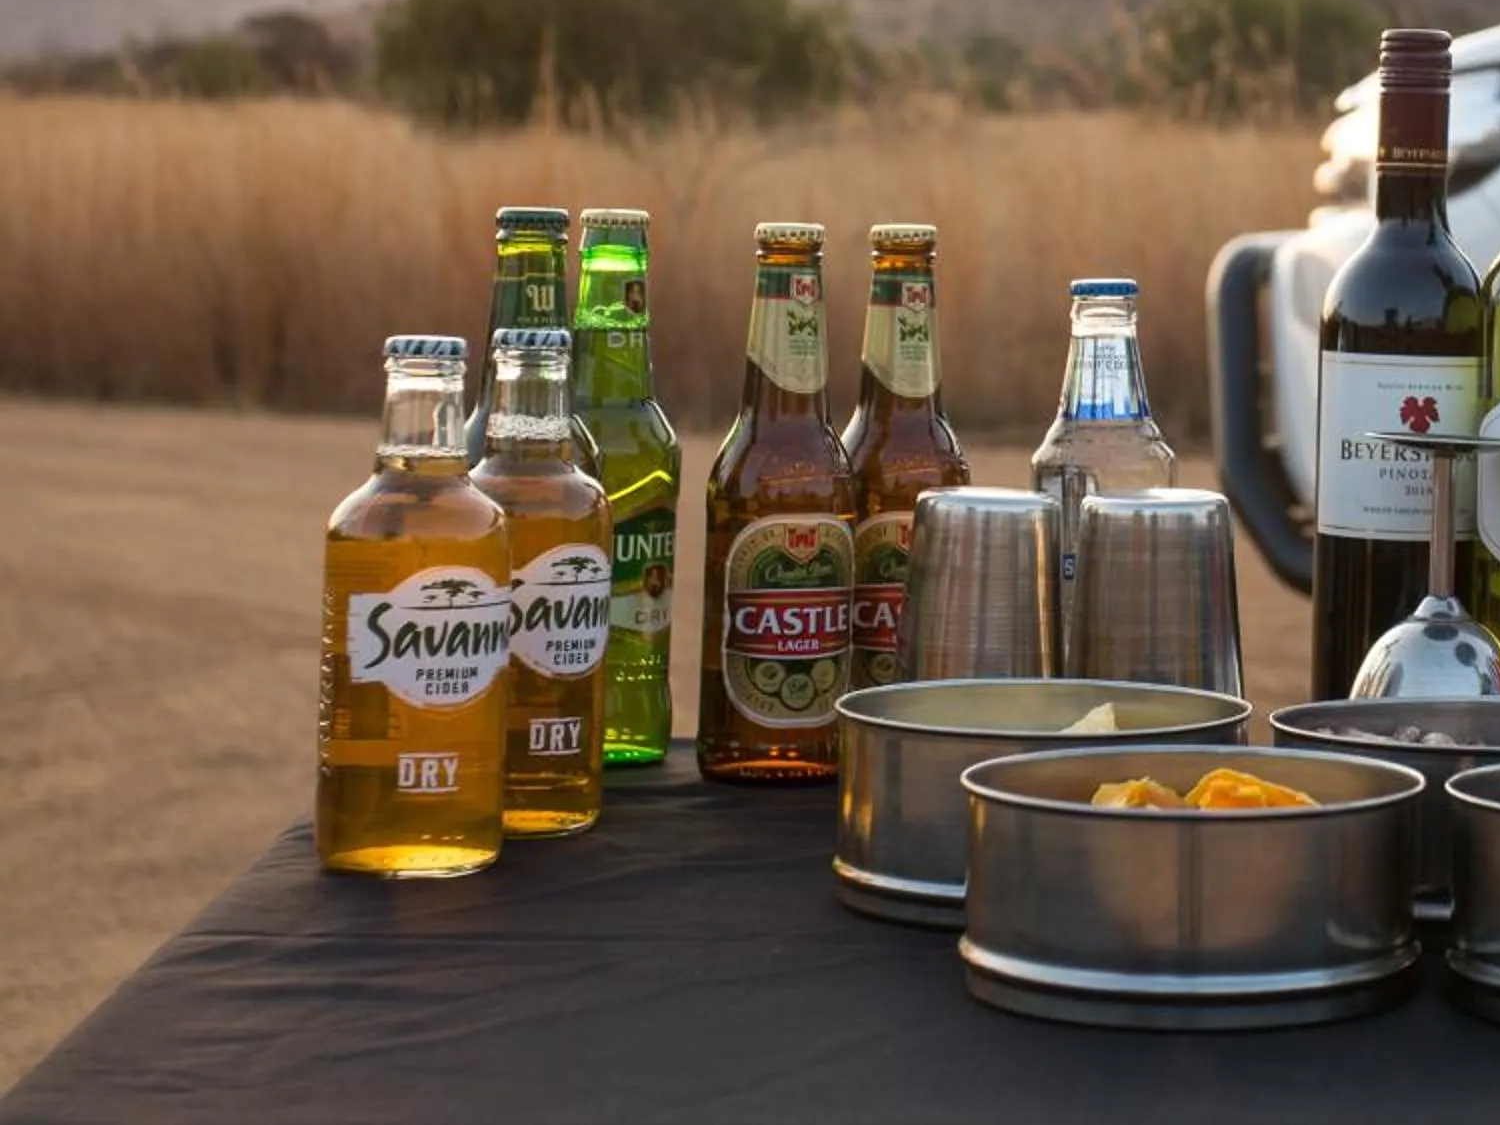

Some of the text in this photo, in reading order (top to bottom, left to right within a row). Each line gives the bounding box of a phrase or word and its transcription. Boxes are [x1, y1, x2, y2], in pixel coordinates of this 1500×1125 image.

[607, 331, 645, 348] DR
[1341, 439, 1476, 463] BEYERS
[1379, 468, 1432, 481] PINOT
[616, 533, 674, 562] UNTE
[735, 604, 848, 635] CASTLE
[364, 602, 510, 669] Savann
[546, 638, 597, 652] PREMIUM
[777, 639, 820, 652] LAGER
[553, 653, 590, 665] CIDER
[416, 666, 478, 681] PREMIUM
[425, 682, 469, 695] CIDER
[530, 720, 581, 751] DRY
[399, 756, 458, 787] DRY
